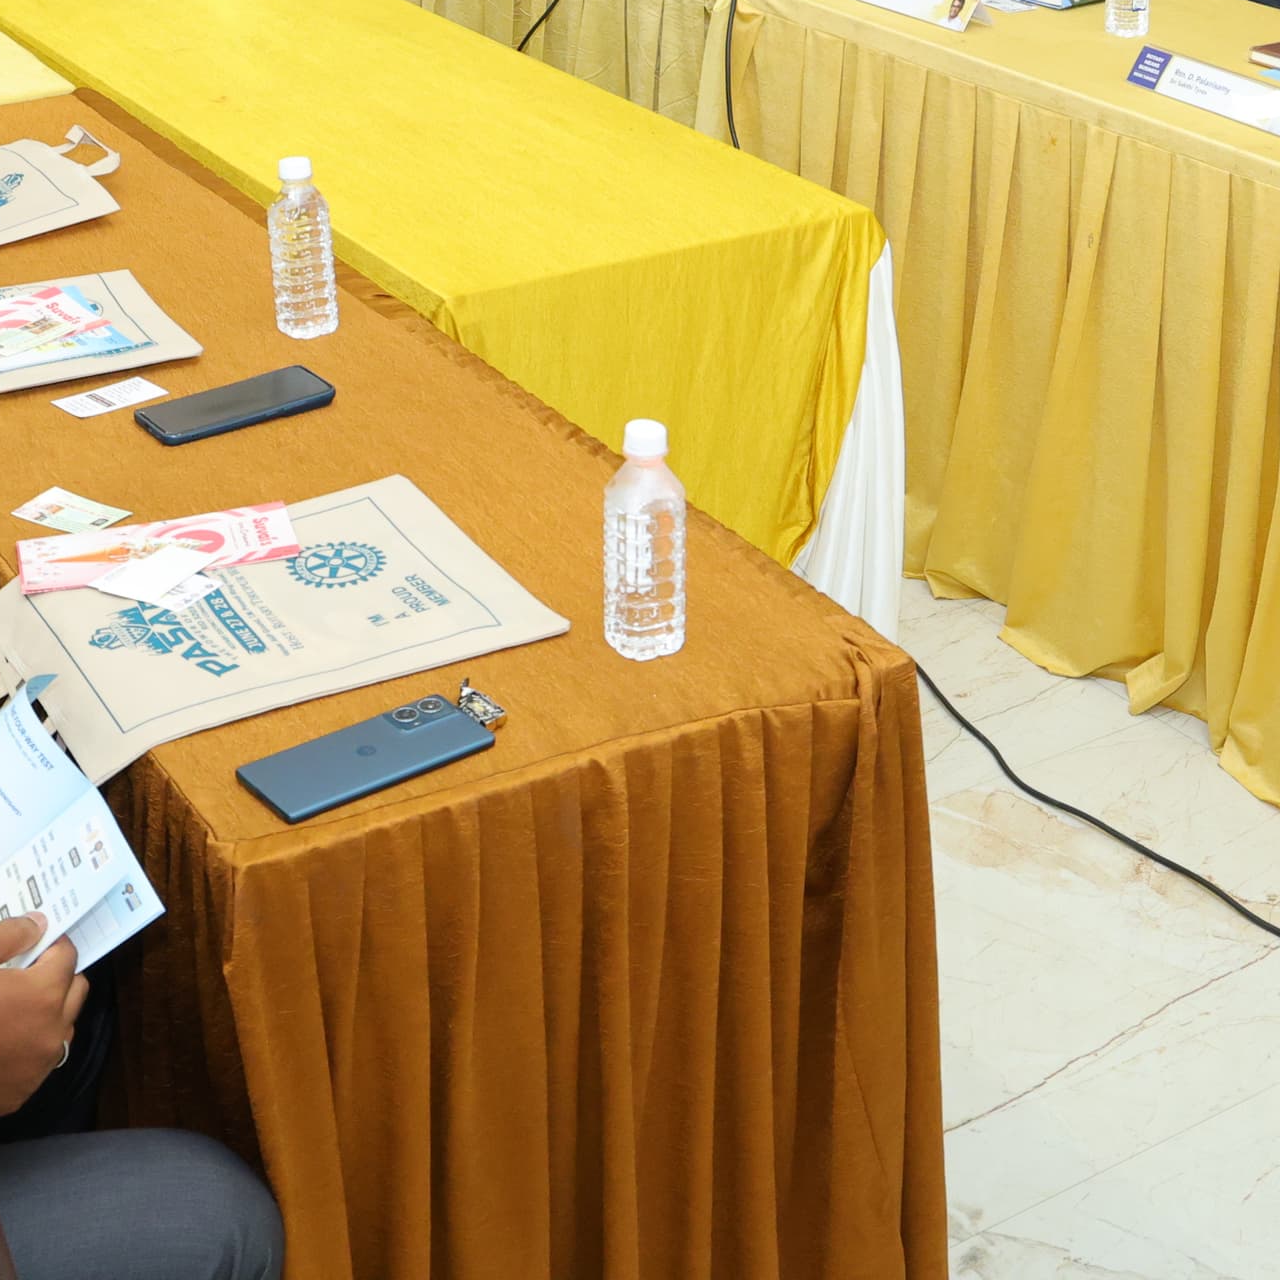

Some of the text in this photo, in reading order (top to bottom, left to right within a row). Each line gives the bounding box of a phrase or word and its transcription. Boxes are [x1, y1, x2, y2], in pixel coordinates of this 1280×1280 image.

[405, 573, 451, 607] MEMBER
[210, 597, 228, 610] 28
[392, 586, 432, 613] PROUD
[226, 617, 244, 628] 27
[368, 613, 391, 627] I'M
[395, 611, 412, 620] A
[137, 600, 240, 678] PASA
[235, 628, 262, 649] JUNE
